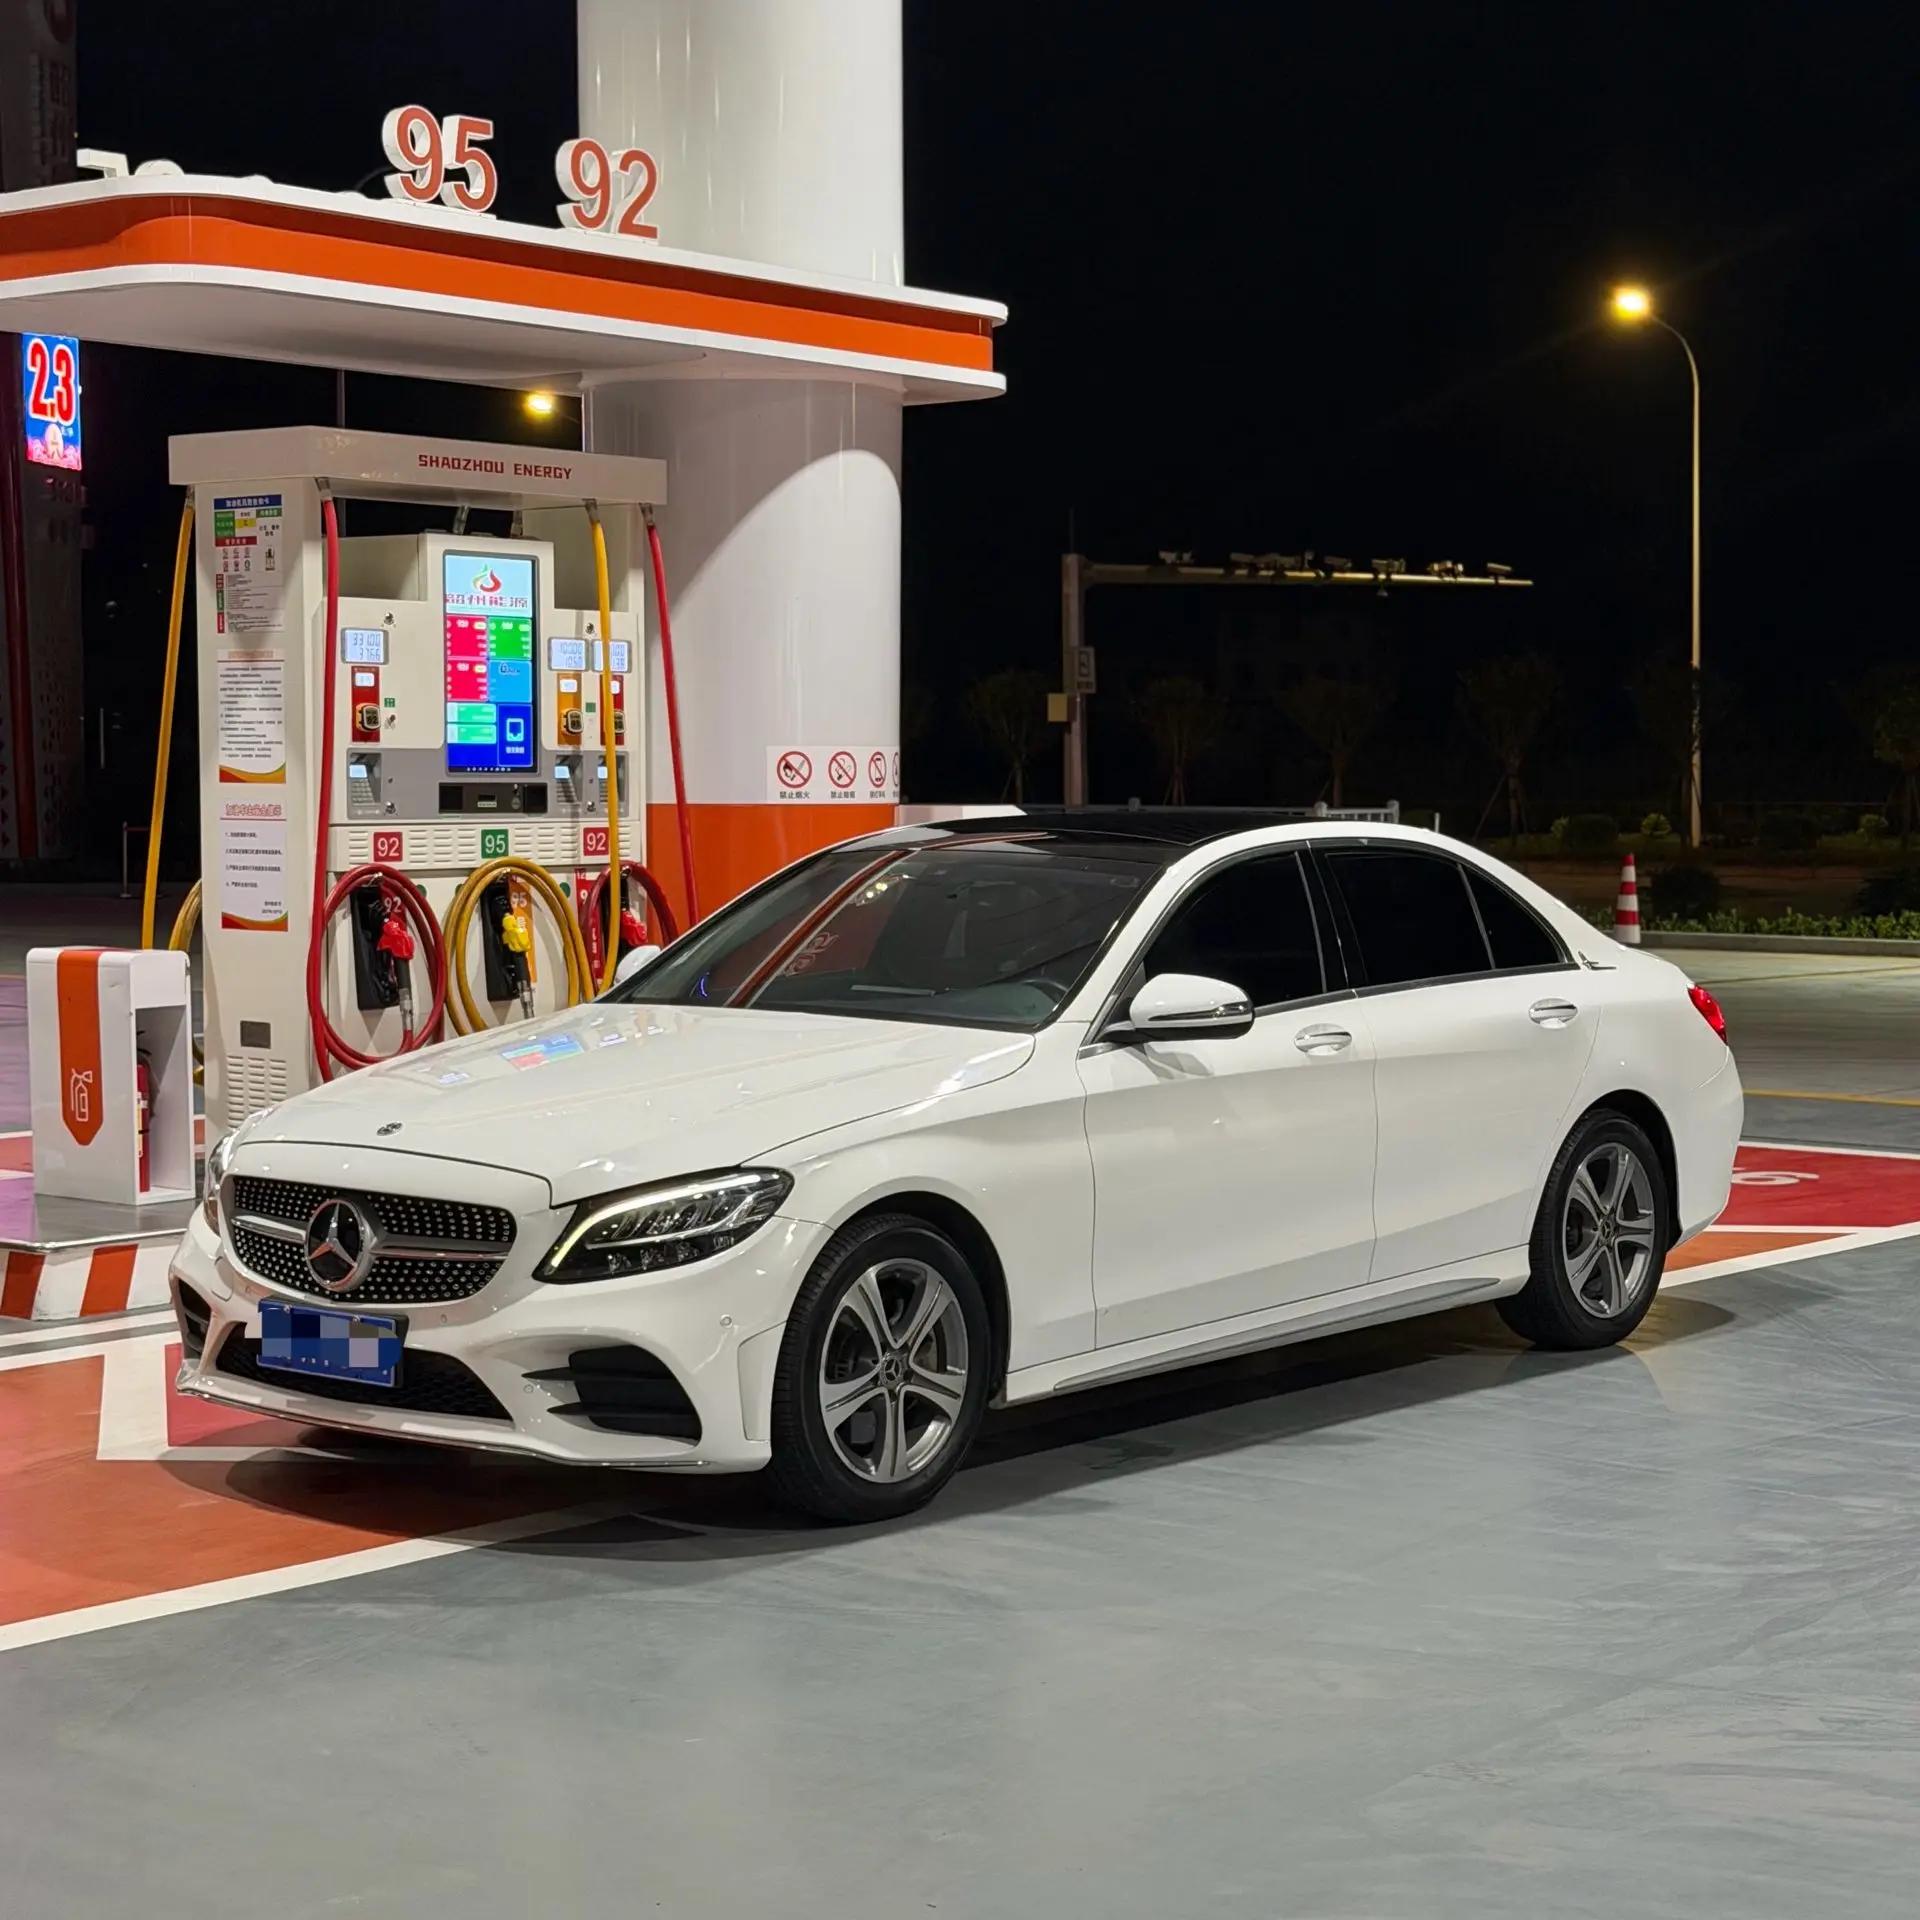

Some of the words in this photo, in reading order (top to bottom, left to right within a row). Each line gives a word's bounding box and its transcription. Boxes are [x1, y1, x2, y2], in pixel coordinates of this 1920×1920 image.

[384, 104, 498, 213] 95
[558, 138, 660, 240] 92
[418, 454, 504, 474] SHAOZHOU
[513, 463, 572, 480] ENERGY
[377, 837, 400, 857] 92
[485, 834, 506, 854] 95
[586, 832, 607, 852] 92
[384, 896, 402, 913] 92
